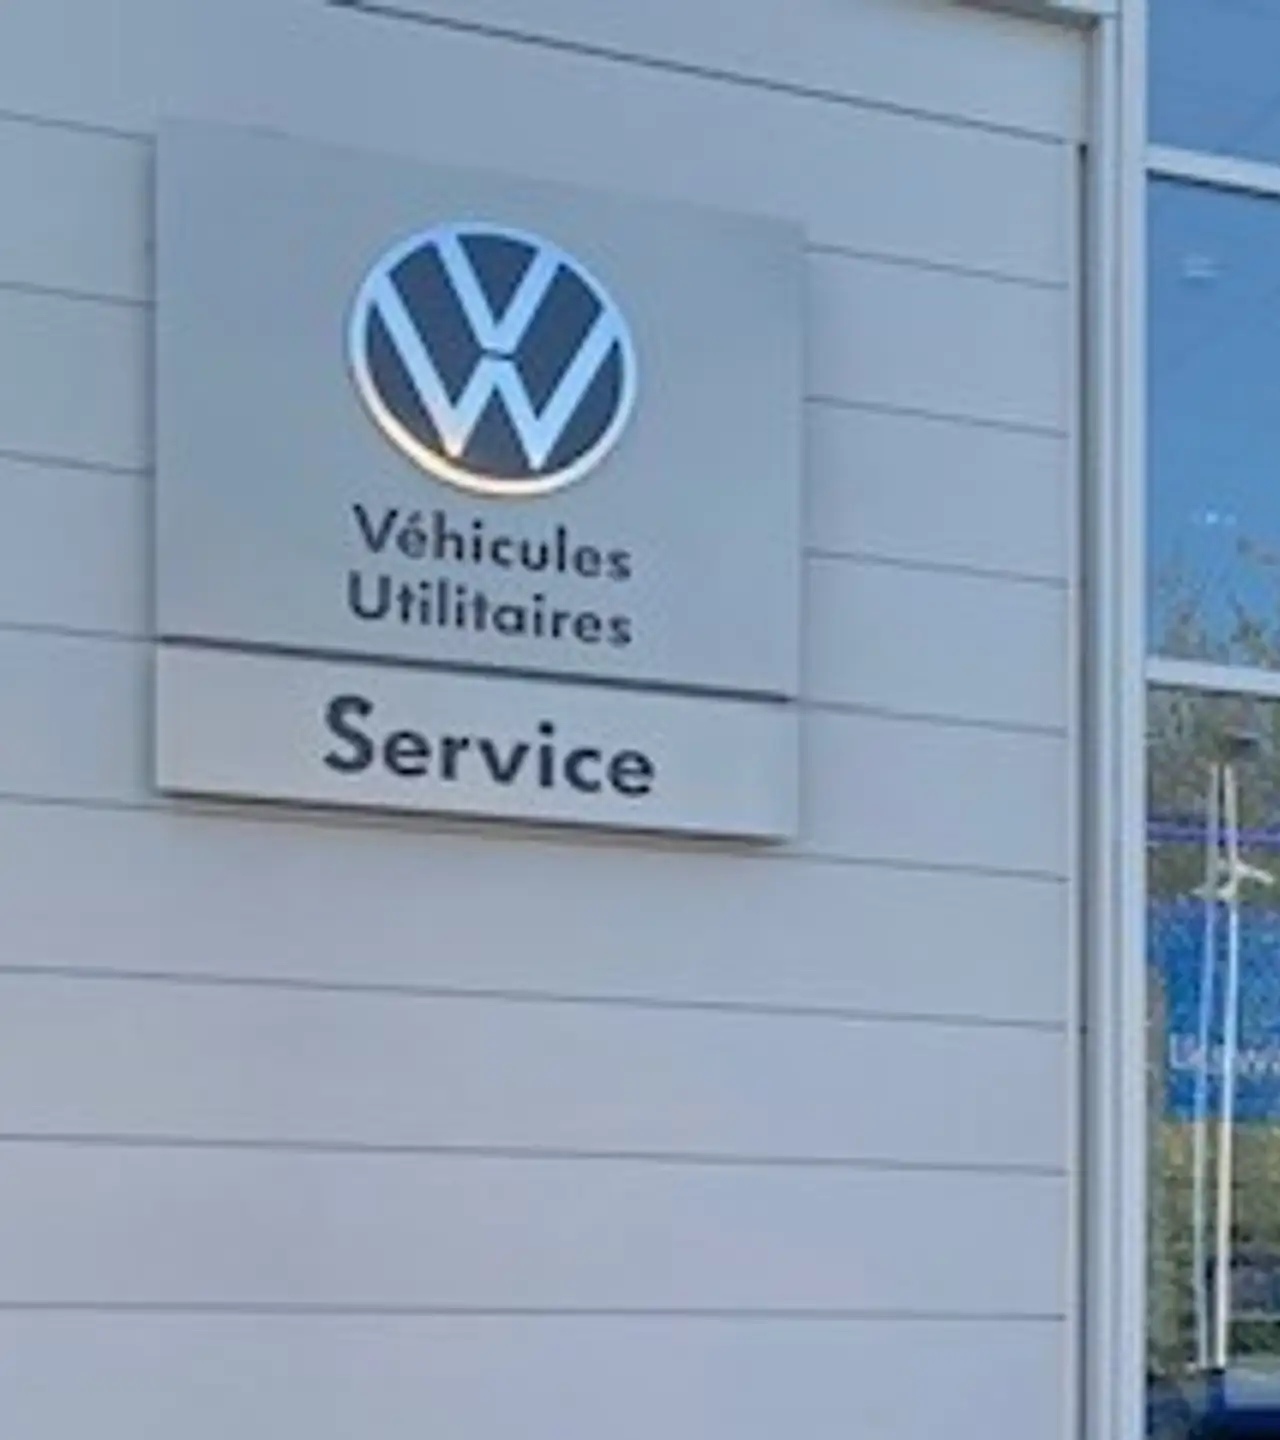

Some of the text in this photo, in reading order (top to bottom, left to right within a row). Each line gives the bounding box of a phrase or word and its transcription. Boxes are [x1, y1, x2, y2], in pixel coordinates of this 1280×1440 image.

[349, 223, 634, 488] VW
[352, 502, 633, 582] Véhicules
[348, 569, 633, 648] Utilitaires
[322, 693, 656, 798] Service
